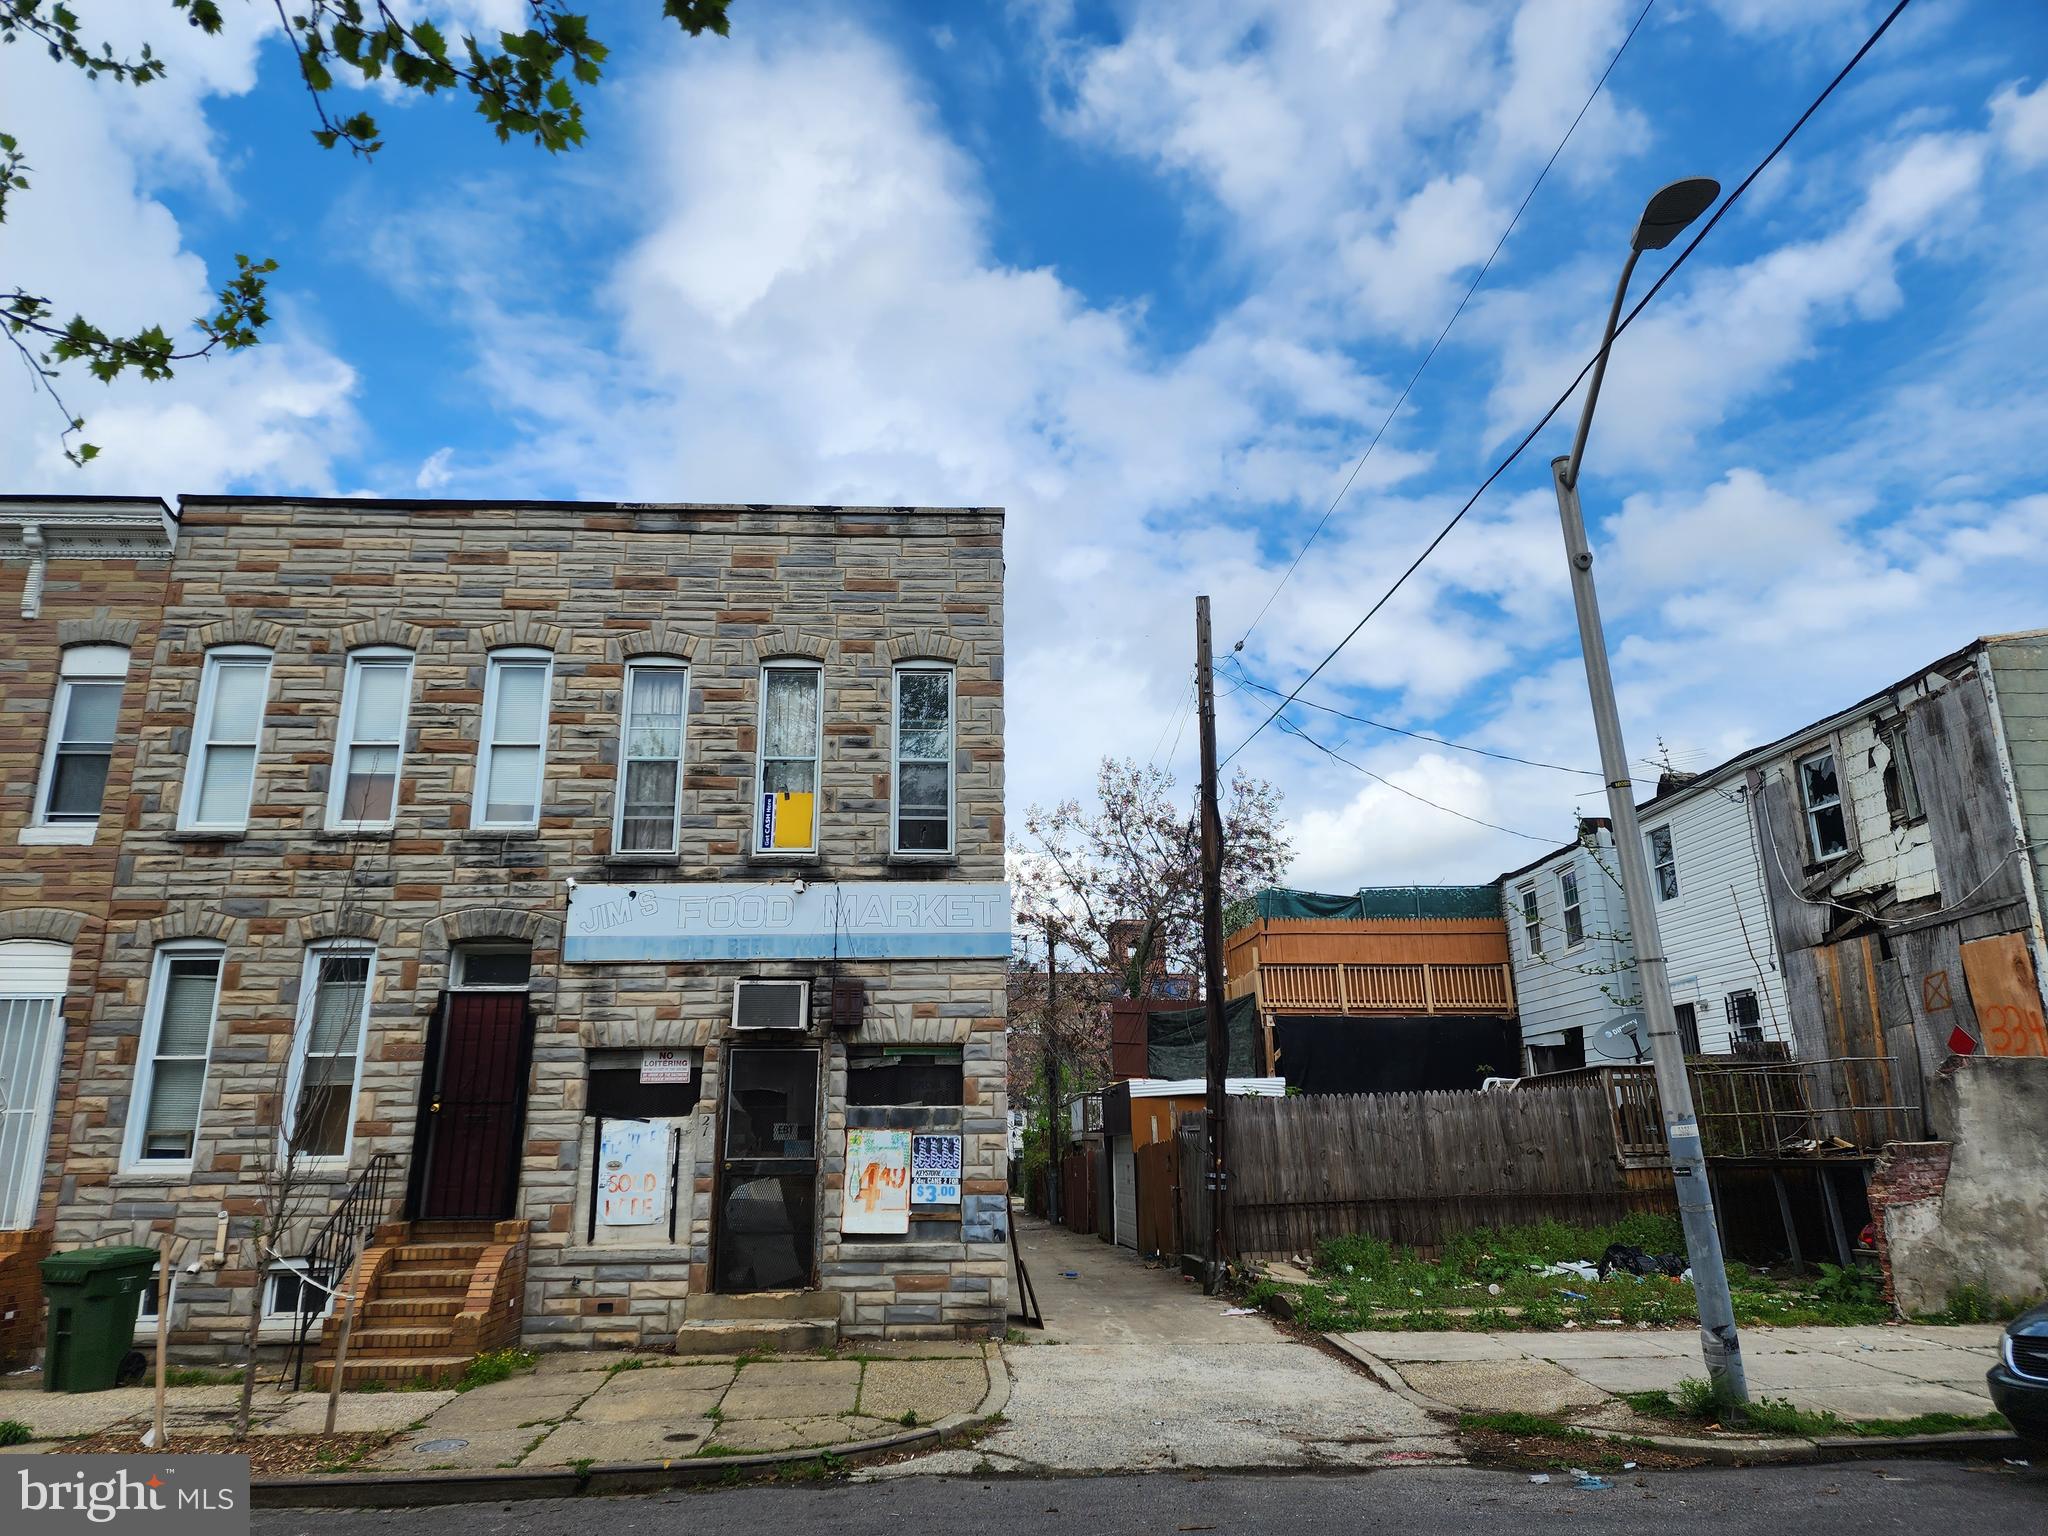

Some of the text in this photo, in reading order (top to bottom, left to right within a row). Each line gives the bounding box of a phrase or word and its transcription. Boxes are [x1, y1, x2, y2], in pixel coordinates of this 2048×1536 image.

[678, 895, 794, 928] FOOD
[824, 895, 1000, 927] MARKET
[659, 1051, 673, 1060] NO
[917, 1185, 955, 1202] $3.00
